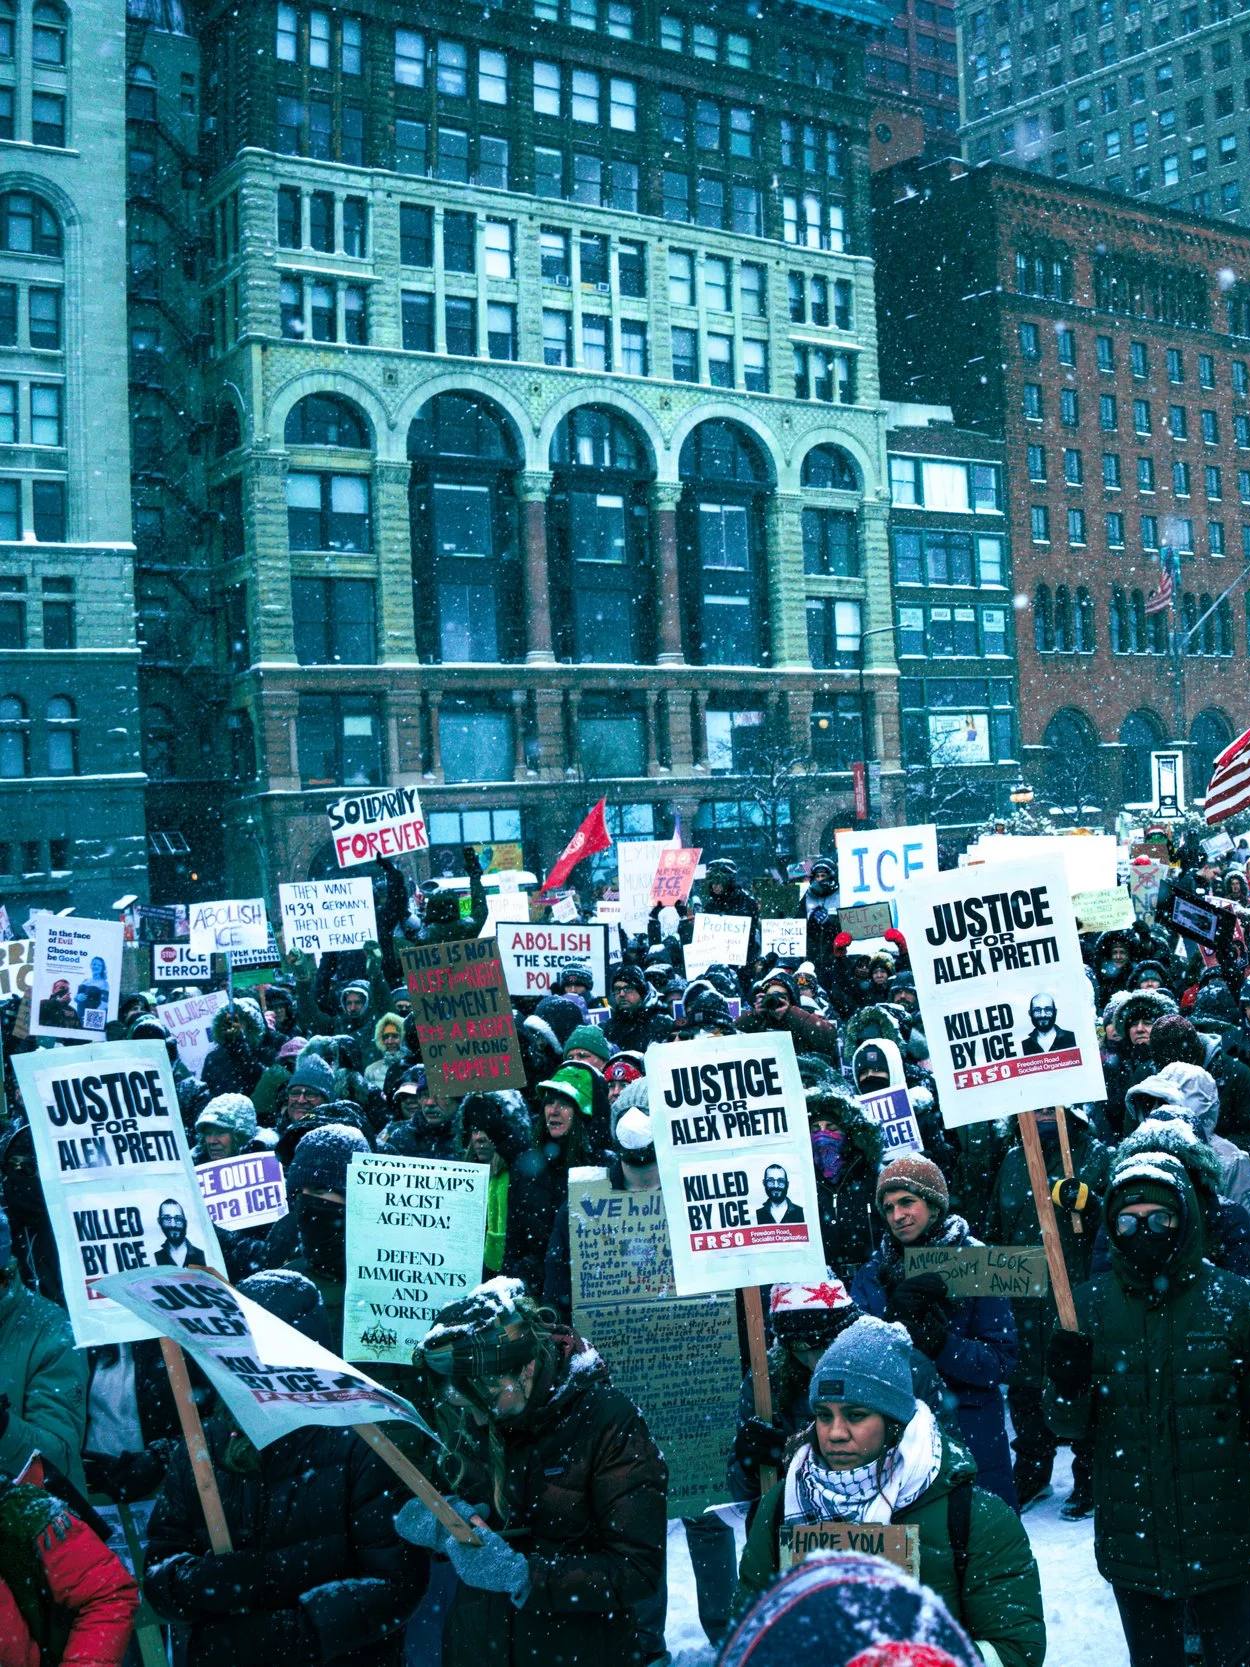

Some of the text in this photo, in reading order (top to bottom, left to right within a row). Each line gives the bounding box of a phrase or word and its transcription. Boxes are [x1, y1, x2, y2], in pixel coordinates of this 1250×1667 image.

[328, 788, 416, 831] SOLIDARITY
[336, 820, 426, 866] FOREVER
[292, 882, 352, 900] THEY WANT
[654, 876, 684, 890] ICE
[193, 904, 261, 930] ABOLISH
[285, 902, 314, 916] 1939
[925, 886, 1054, 946] JUSTICE
[334, 914, 354, 928] GET
[703, 916, 747, 934] Protest
[48, 928, 91, 940] In the face
[48, 936, 73, 945] of Evil
[214, 926, 244, 950] ICE
[292, 935, 320, 950] 1789
[512, 932, 592, 952] ABOLISH
[970, 932, 1015, 950] FOR
[47, 953, 80, 964] be Good
[48, 946, 88, 957] Choose to
[402, 940, 496, 970] THIS IS NOT
[513, 954, 540, 968] THE
[933, 936, 1060, 984] ALEX PRETTI
[157, 966, 208, 977] TERROR
[421, 960, 503, 992] LEFT RIGHT
[177, 995, 219, 1026] LIKE
[422, 987, 500, 1021] MOMENT
[451, 1015, 514, 1040] A RIGHT
[944, 1003, 1014, 1042] KILLED
[428, 1038, 509, 1059] or WRONG
[950, 1032, 1018, 1070] BY ICE
[442, 1056, 512, 1083] MOMENT
[1016, 1056, 1060, 1068] Freedom Road
[1018, 1058, 1080, 1074] Socialist Organization
[664, 1058, 783, 1109] JUSTICE
[957, 1064, 1012, 1088] FRSO
[46, 1070, 169, 1128] JUSTICE
[705, 1100, 747, 1114] FOR
[92, 1118, 138, 1136] FOR
[671, 1106, 789, 1146] ALEX PRETTI
[58, 1130, 180, 1172] ALEX PRETTI
[219, 1160, 265, 1192] OUT!
[356, 1170, 474, 1193] STOP TRUMP'S
[683, 1171, 748, 1202] KILLED
[242, 1184, 282, 1214] ICE!
[385, 1192, 444, 1210] RACIST
[580, 1195, 660, 1218] WE hold
[73, 1206, 144, 1242] KILLED
[376, 1212, 451, 1230] AGENDA!
[688, 1200, 750, 1231] BY ICE
[576, 1224, 620, 1239] truths
[694, 1231, 744, 1251] FRSO
[750, 1230, 776, 1238] Freedom
[751, 1234, 808, 1244] Socialist Organization
[578, 1240, 598, 1251] that
[580, 1250, 599, 1260] they
[80, 1240, 150, 1277] BY ICE
[376, 1248, 445, 1266] DEFEND
[582, 1258, 628, 1271] Creator
[908, 1250, 957, 1272] America,
[988, 1252, 1033, 1275] LOOK
[358, 1266, 468, 1288] IMMIGRANTS
[938, 1260, 980, 1282] DON'T
[392, 1287, 428, 1302] AND
[990, 1273, 1030, 1295] AWAY
[360, 1330, 398, 1346] AAAN
[236, 1373, 331, 1392] BY ICE
[796, 1530, 885, 1555] HOPE YOU
